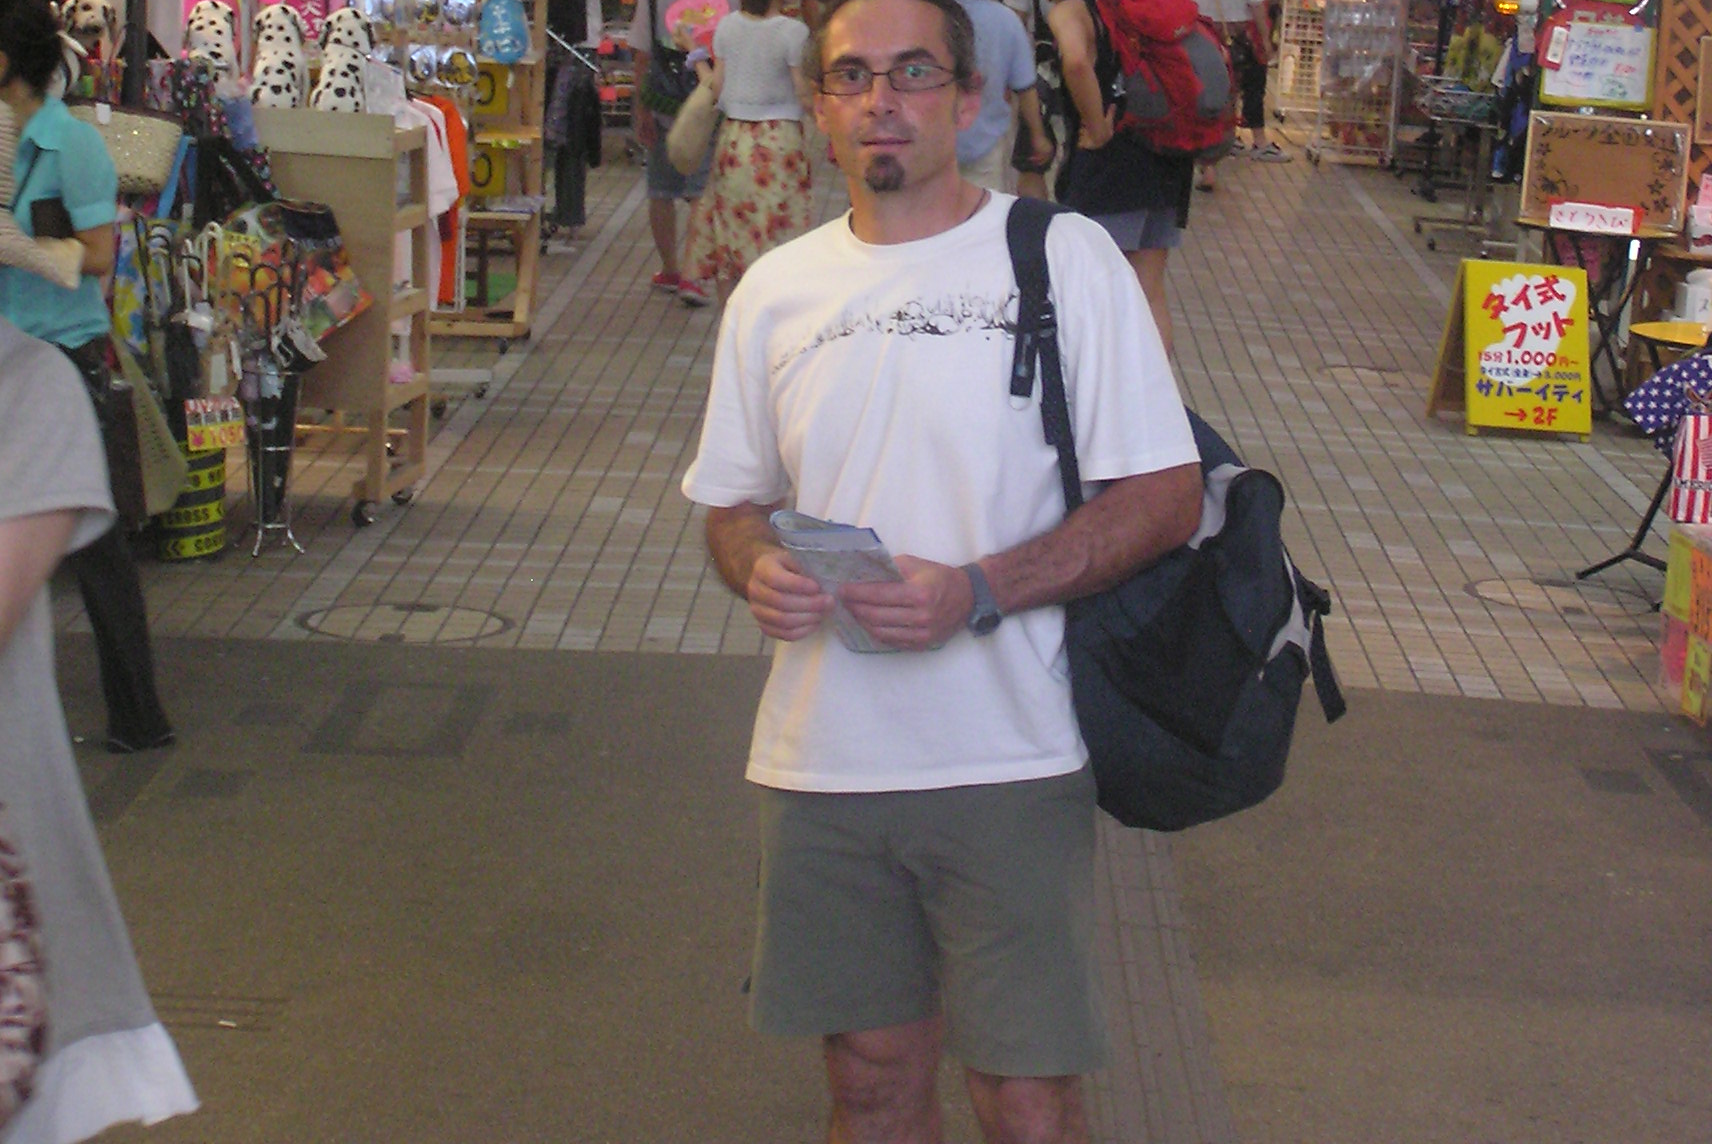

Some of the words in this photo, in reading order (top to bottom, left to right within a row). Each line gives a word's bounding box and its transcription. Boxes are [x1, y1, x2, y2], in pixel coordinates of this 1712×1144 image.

[1481, 274, 1567, 320] タイ式
[1501, 310, 1575, 350] フット
[1532, 406, 1559, 426] 2F
